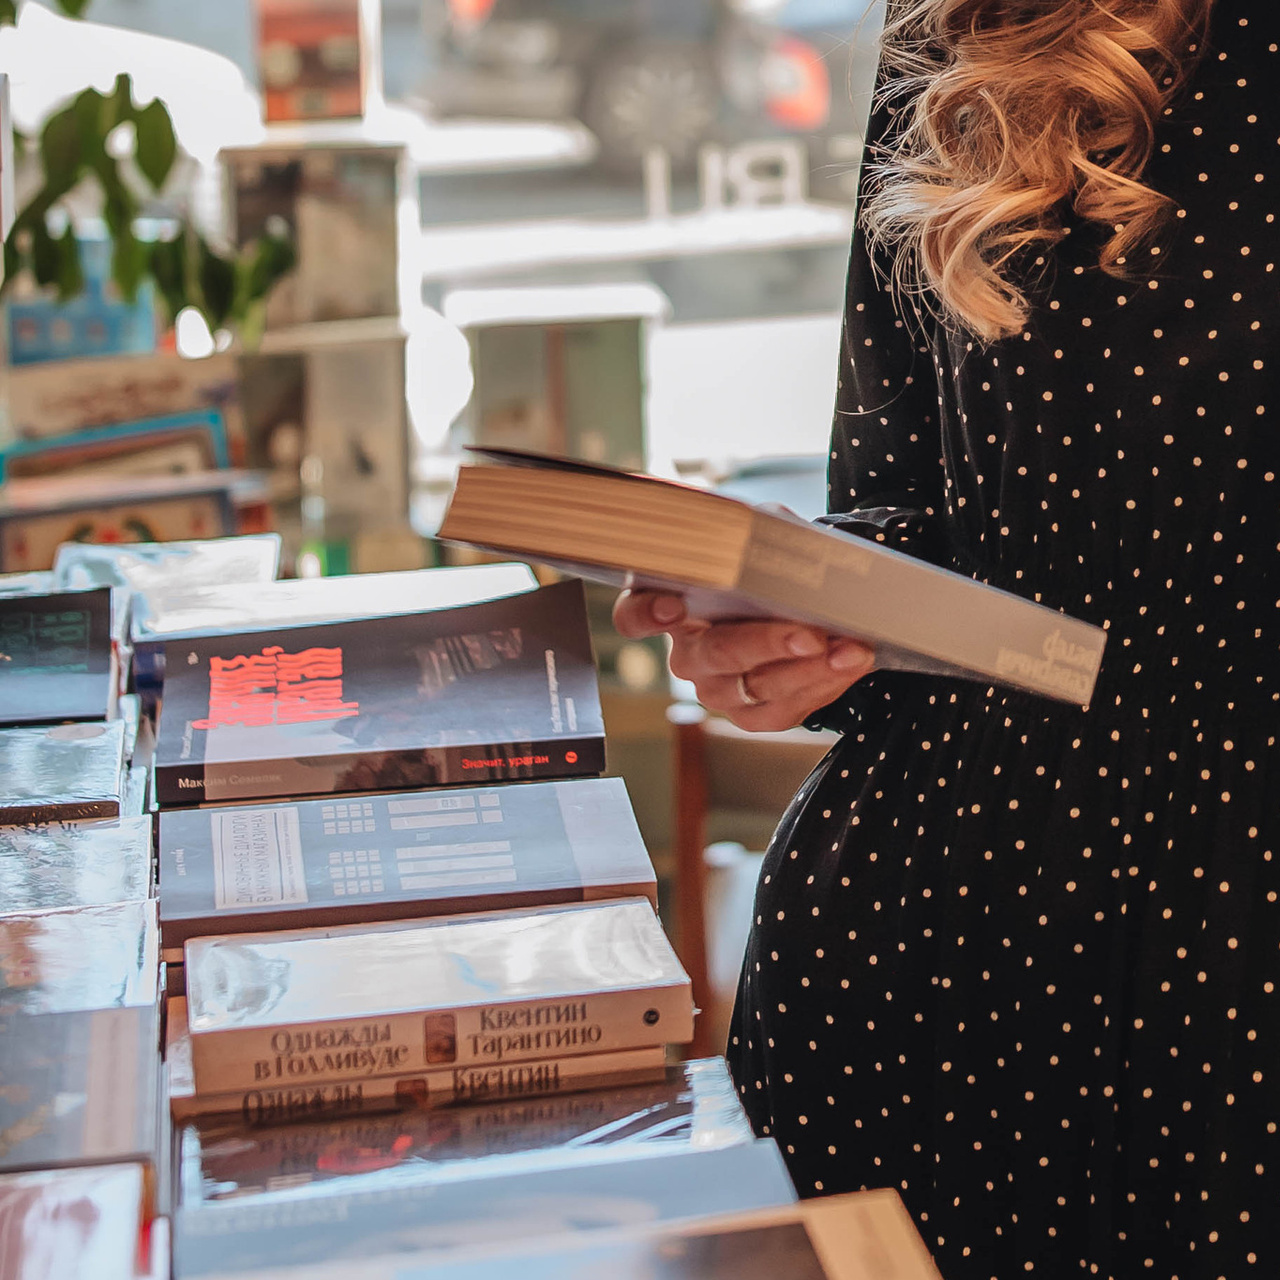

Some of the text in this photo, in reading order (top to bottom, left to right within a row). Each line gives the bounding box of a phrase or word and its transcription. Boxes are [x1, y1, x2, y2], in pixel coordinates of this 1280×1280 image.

[508, 755, 549, 768] ураган
[178, 776, 226, 789] Максим
[231, 814, 250, 850] ДИАЛОГИ
[251, 813, 269, 857] МАГАЗИНАХ
[479, 1001, 588, 1032] Квентин
[270, 1022, 392, 1057] Однажды
[466, 1023, 602, 1059] Тарантино
[275, 1045, 409, 1076] Голливуде
